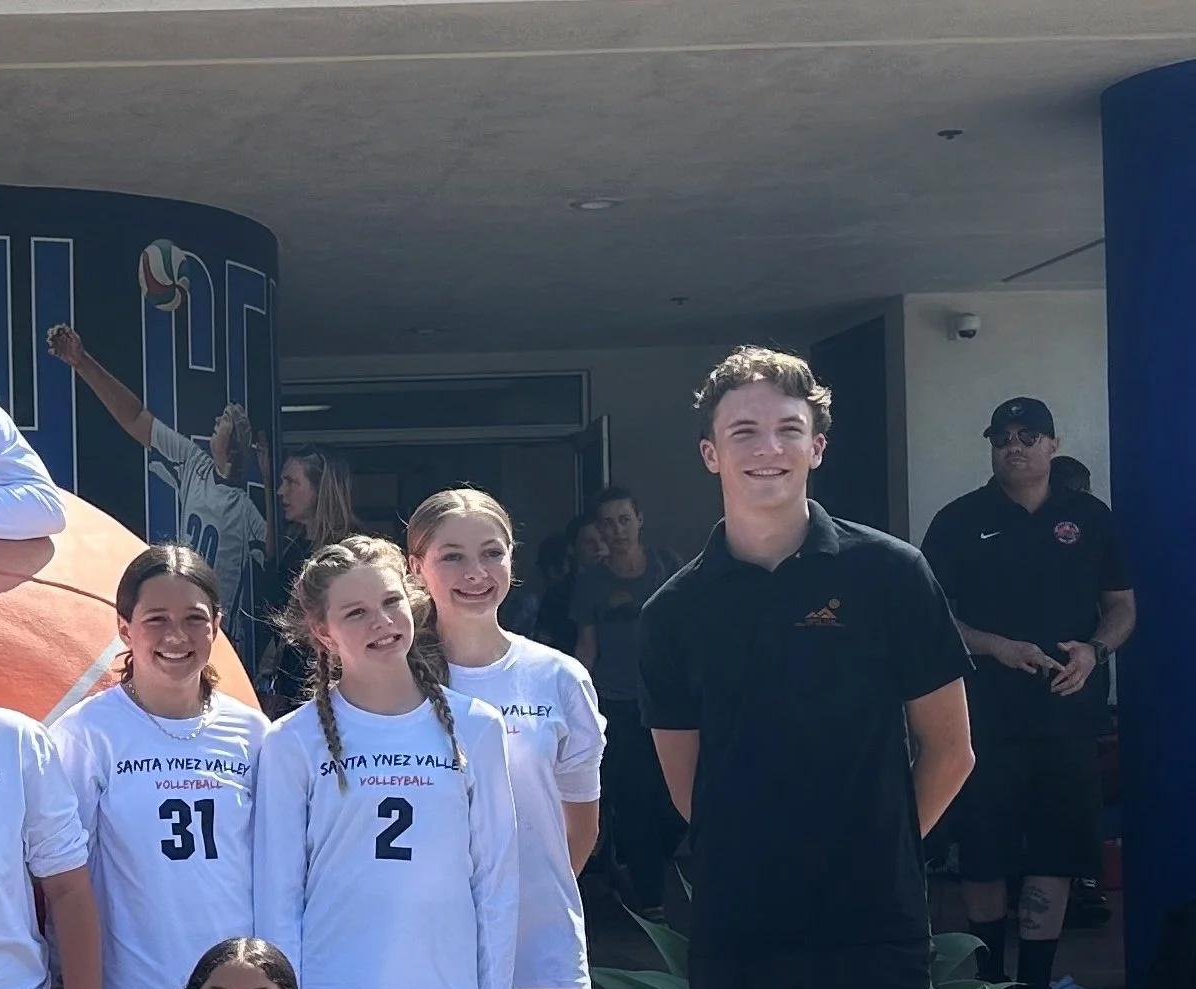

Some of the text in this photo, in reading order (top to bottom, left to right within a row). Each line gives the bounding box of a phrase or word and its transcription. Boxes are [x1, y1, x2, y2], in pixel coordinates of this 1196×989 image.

[500, 704, 552, 718] VALLEY
[116, 757, 251, 777] SANTA YNEZ VALLEY
[372, 754, 411, 767] YNEZ
[415, 754, 460, 771] VALLE
[155, 779, 223, 790] VOLLEYBALL
[359, 775, 434, 787] VOLLEYBALL
[158, 798, 218, 861] 31
[375, 796, 414, 861] 2
